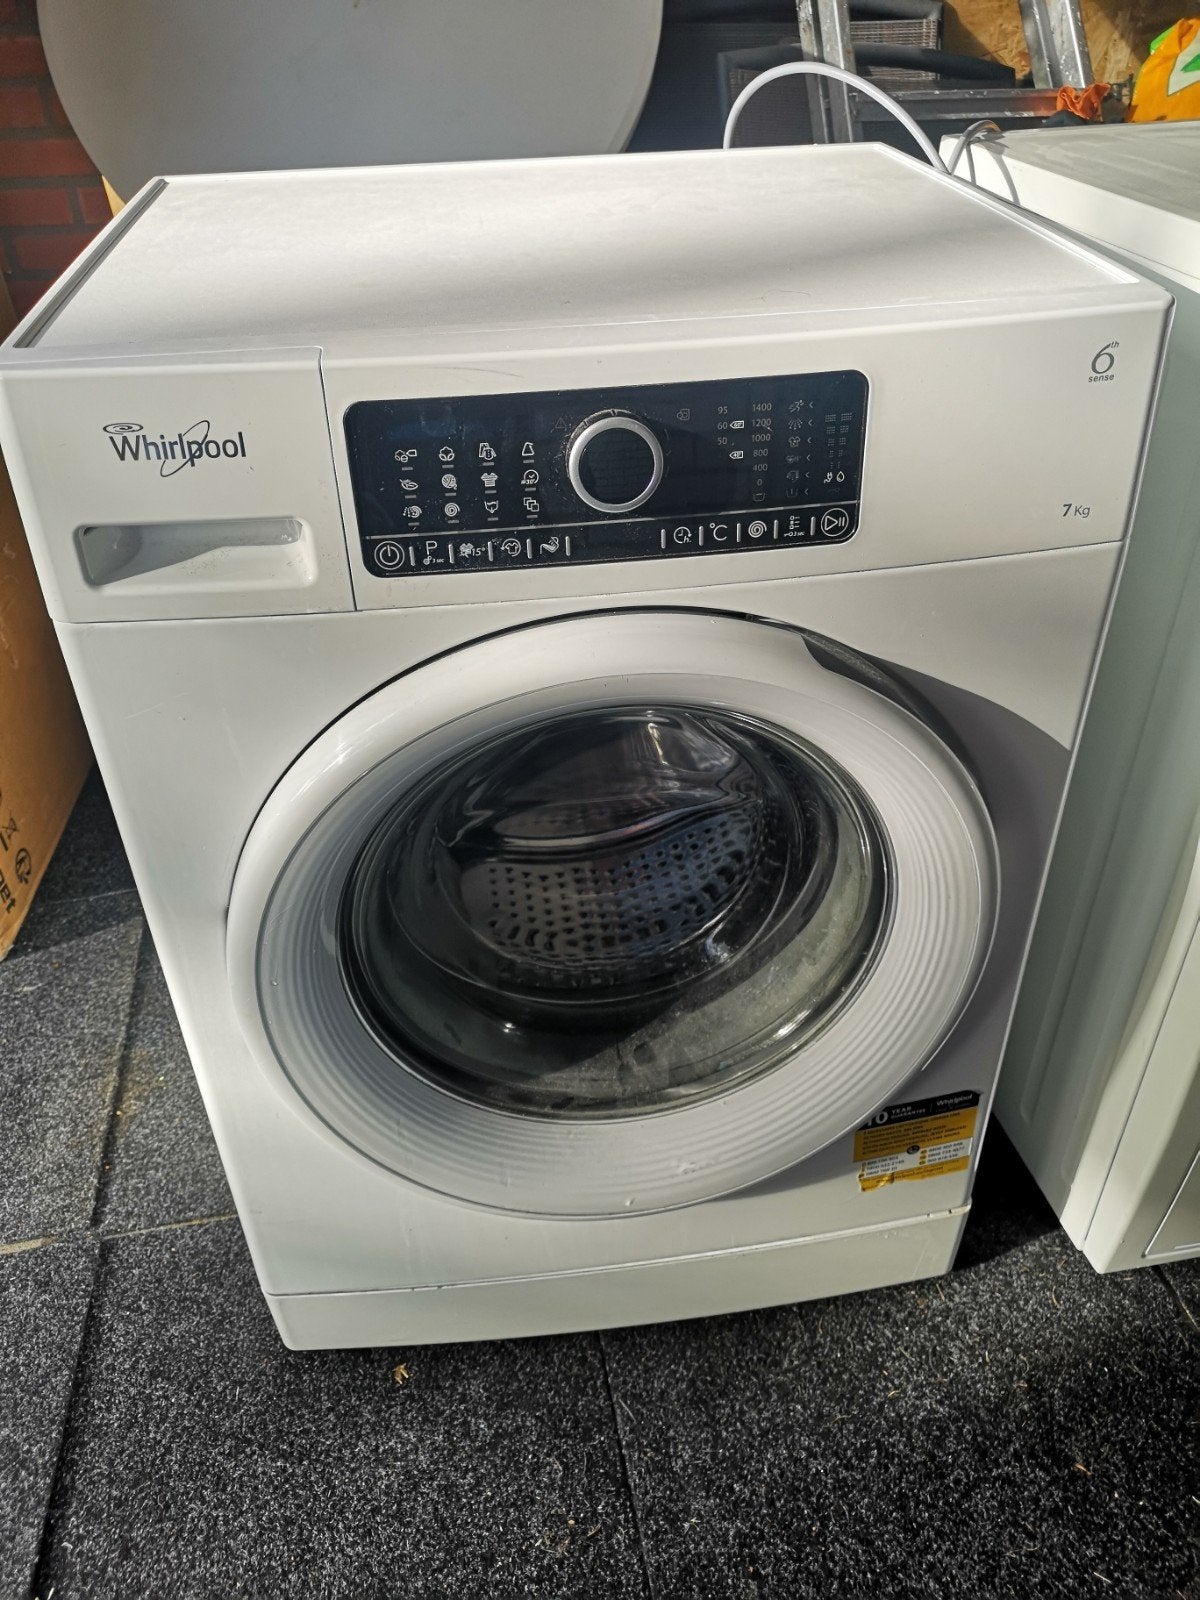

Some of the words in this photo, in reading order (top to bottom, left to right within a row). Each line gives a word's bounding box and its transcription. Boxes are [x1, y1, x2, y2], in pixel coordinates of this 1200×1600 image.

[1088, 373, 1115, 383] sense
[717, 406, 728, 414] 95
[752, 402, 772, 412] 1400
[717, 421, 728, 430] 60
[751, 418, 772, 427] 1200
[717, 437, 728, 445] 50
[751, 433, 771, 442] 1000
[108, 431, 247, 468] Whirlpool
[752, 448, 769, 457] 800
[752, 463, 768, 472] 400
[1062, 503, 1073, 517] 7
[1074, 504, 1091, 519] Kg
[425, 540, 438, 555] P
[936, 1094, 973, 1106] Whirlpool
[891, 1106, 912, 1115] YEAR
